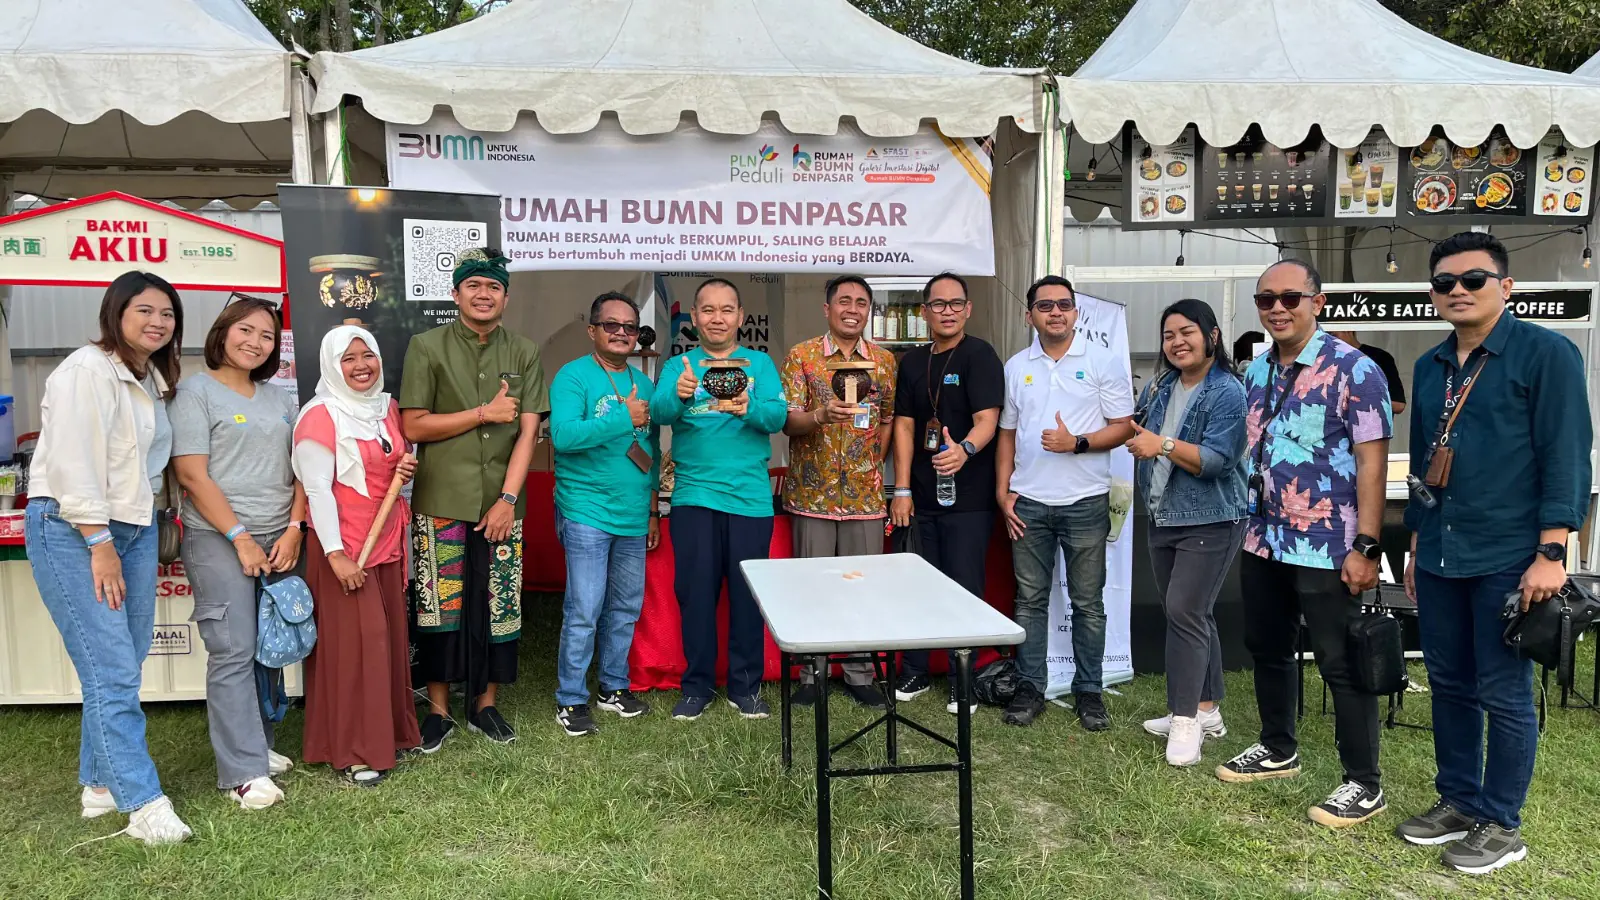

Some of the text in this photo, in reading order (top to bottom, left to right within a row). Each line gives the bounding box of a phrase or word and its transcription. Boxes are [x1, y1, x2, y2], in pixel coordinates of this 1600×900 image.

[487, 144, 518, 152] UNTUK
[487, 153, 536, 162] INDONESIA
[730, 155, 756, 167] PLN
[814, 152, 854, 161] RUMAH
[814, 161, 854, 172] BUMN
[916, 161, 940, 174] Digital
[730, 166, 783, 184] Peduli
[792, 173, 854, 182] DENPASAR
[500, 198, 907, 226] UMAH BUMN DENPASAR
[86, 220, 148, 233] BAKMI
[506, 232, 887, 247] RUMAH BERSAMA untuk BERKUMPUL, SALING BELAJAR
[4, 238, 41, 255] 肉面
[69, 236, 167, 263] AKIU
[201, 246, 233, 257] 1985
[509, 248, 914, 265] terus bertumbuh menjadi UMKM Indonesia yang BERDAYA.
[1324, 304, 1386, 318] TAKA'S
[1505, 302, 1565, 315] COFFEE
